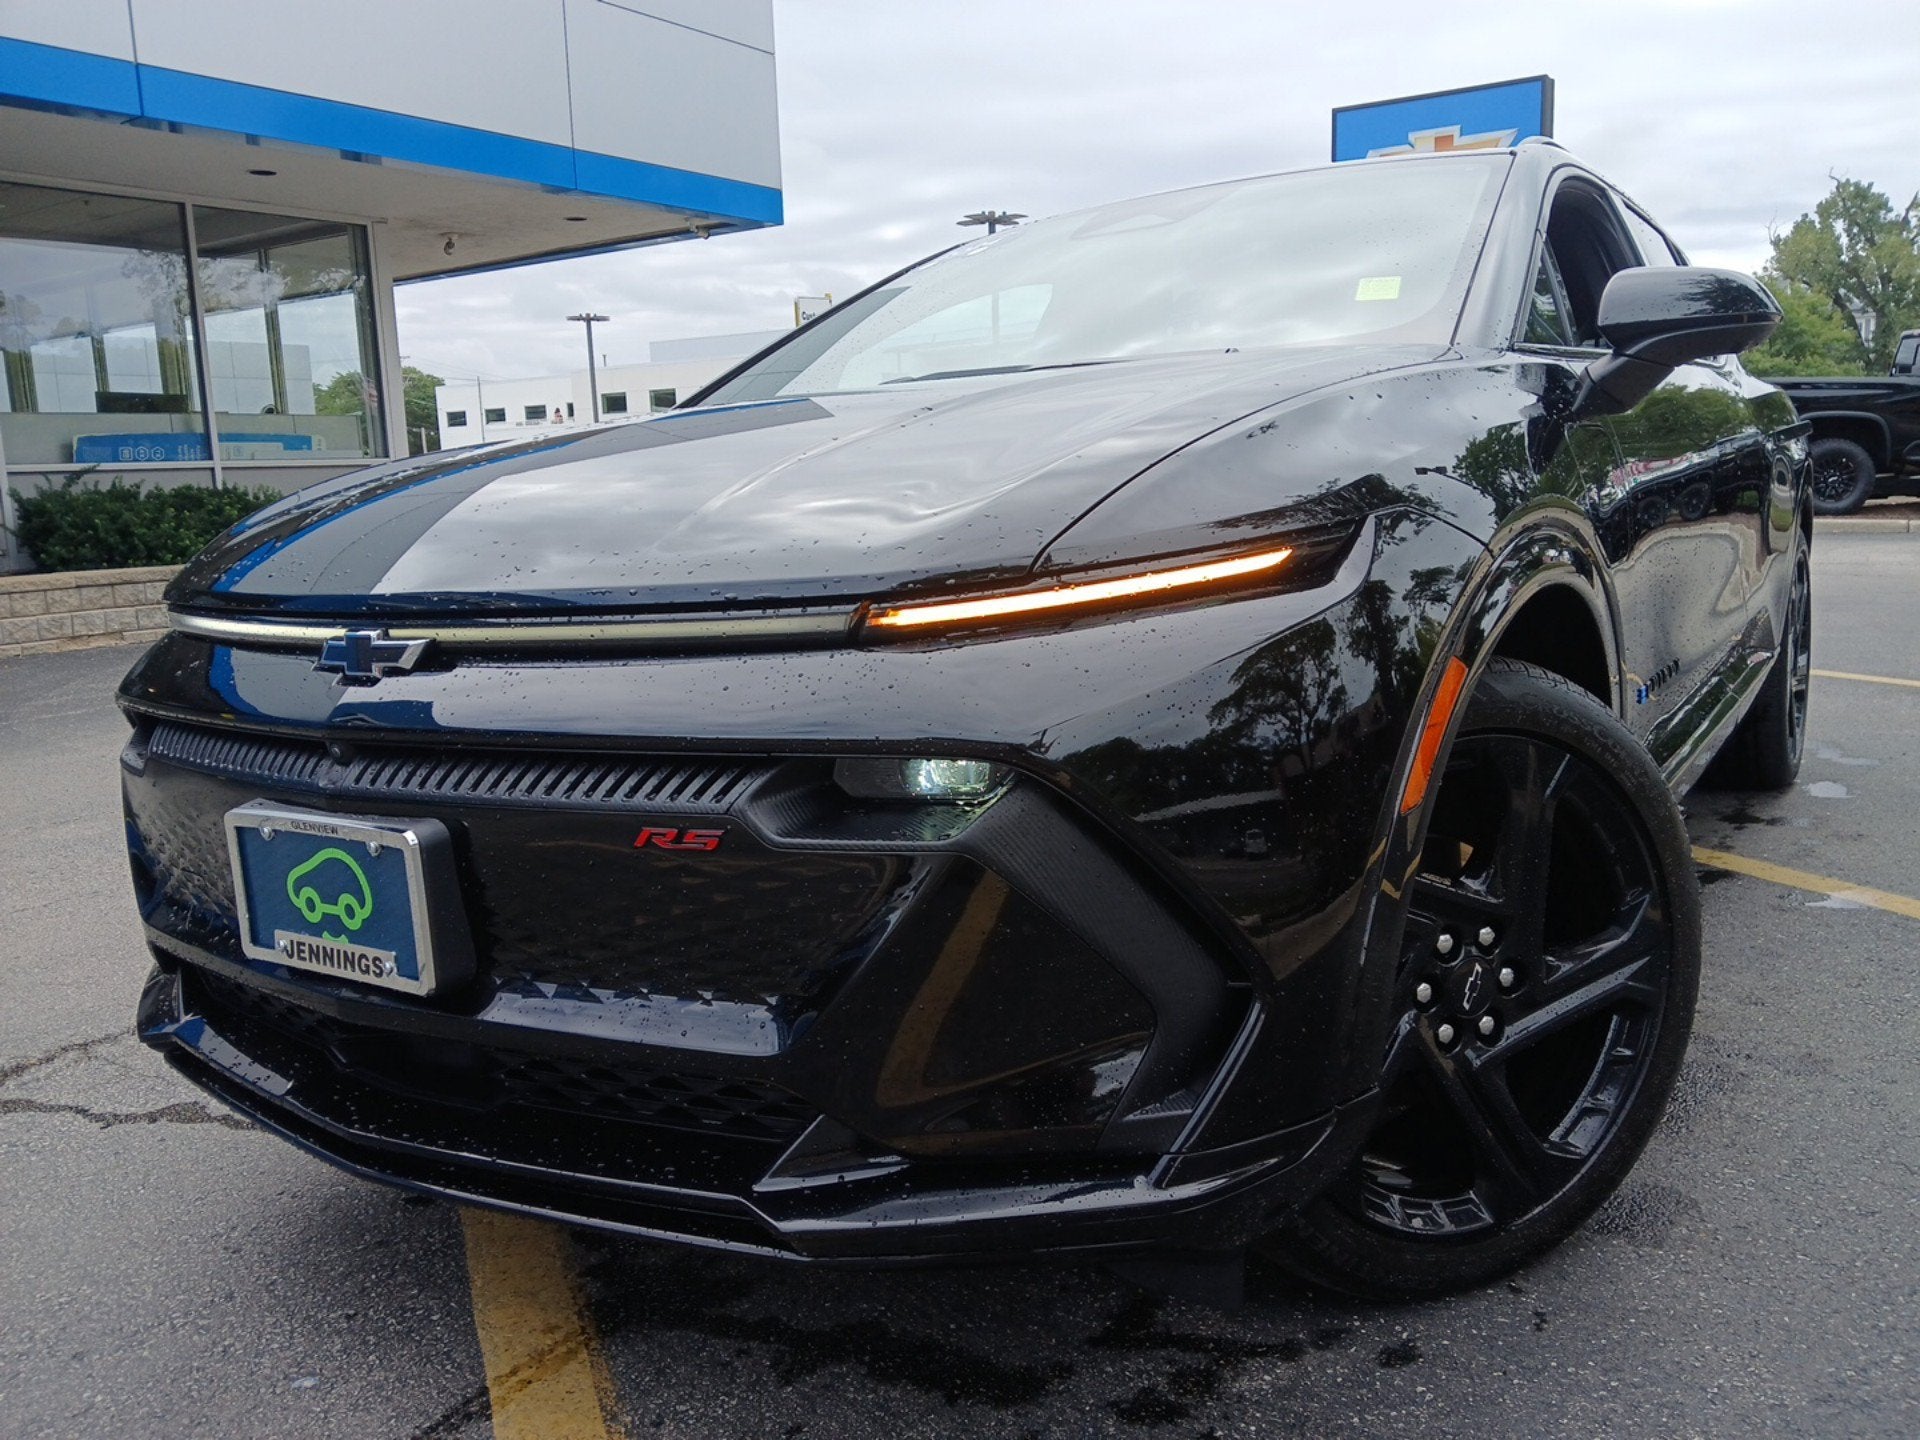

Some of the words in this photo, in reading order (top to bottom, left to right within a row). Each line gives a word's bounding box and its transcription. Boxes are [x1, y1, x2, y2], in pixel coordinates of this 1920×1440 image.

[290, 820, 338, 835] GLENVIEW
[633, 827, 725, 851] RS
[285, 939, 384, 978] JENNINGS
